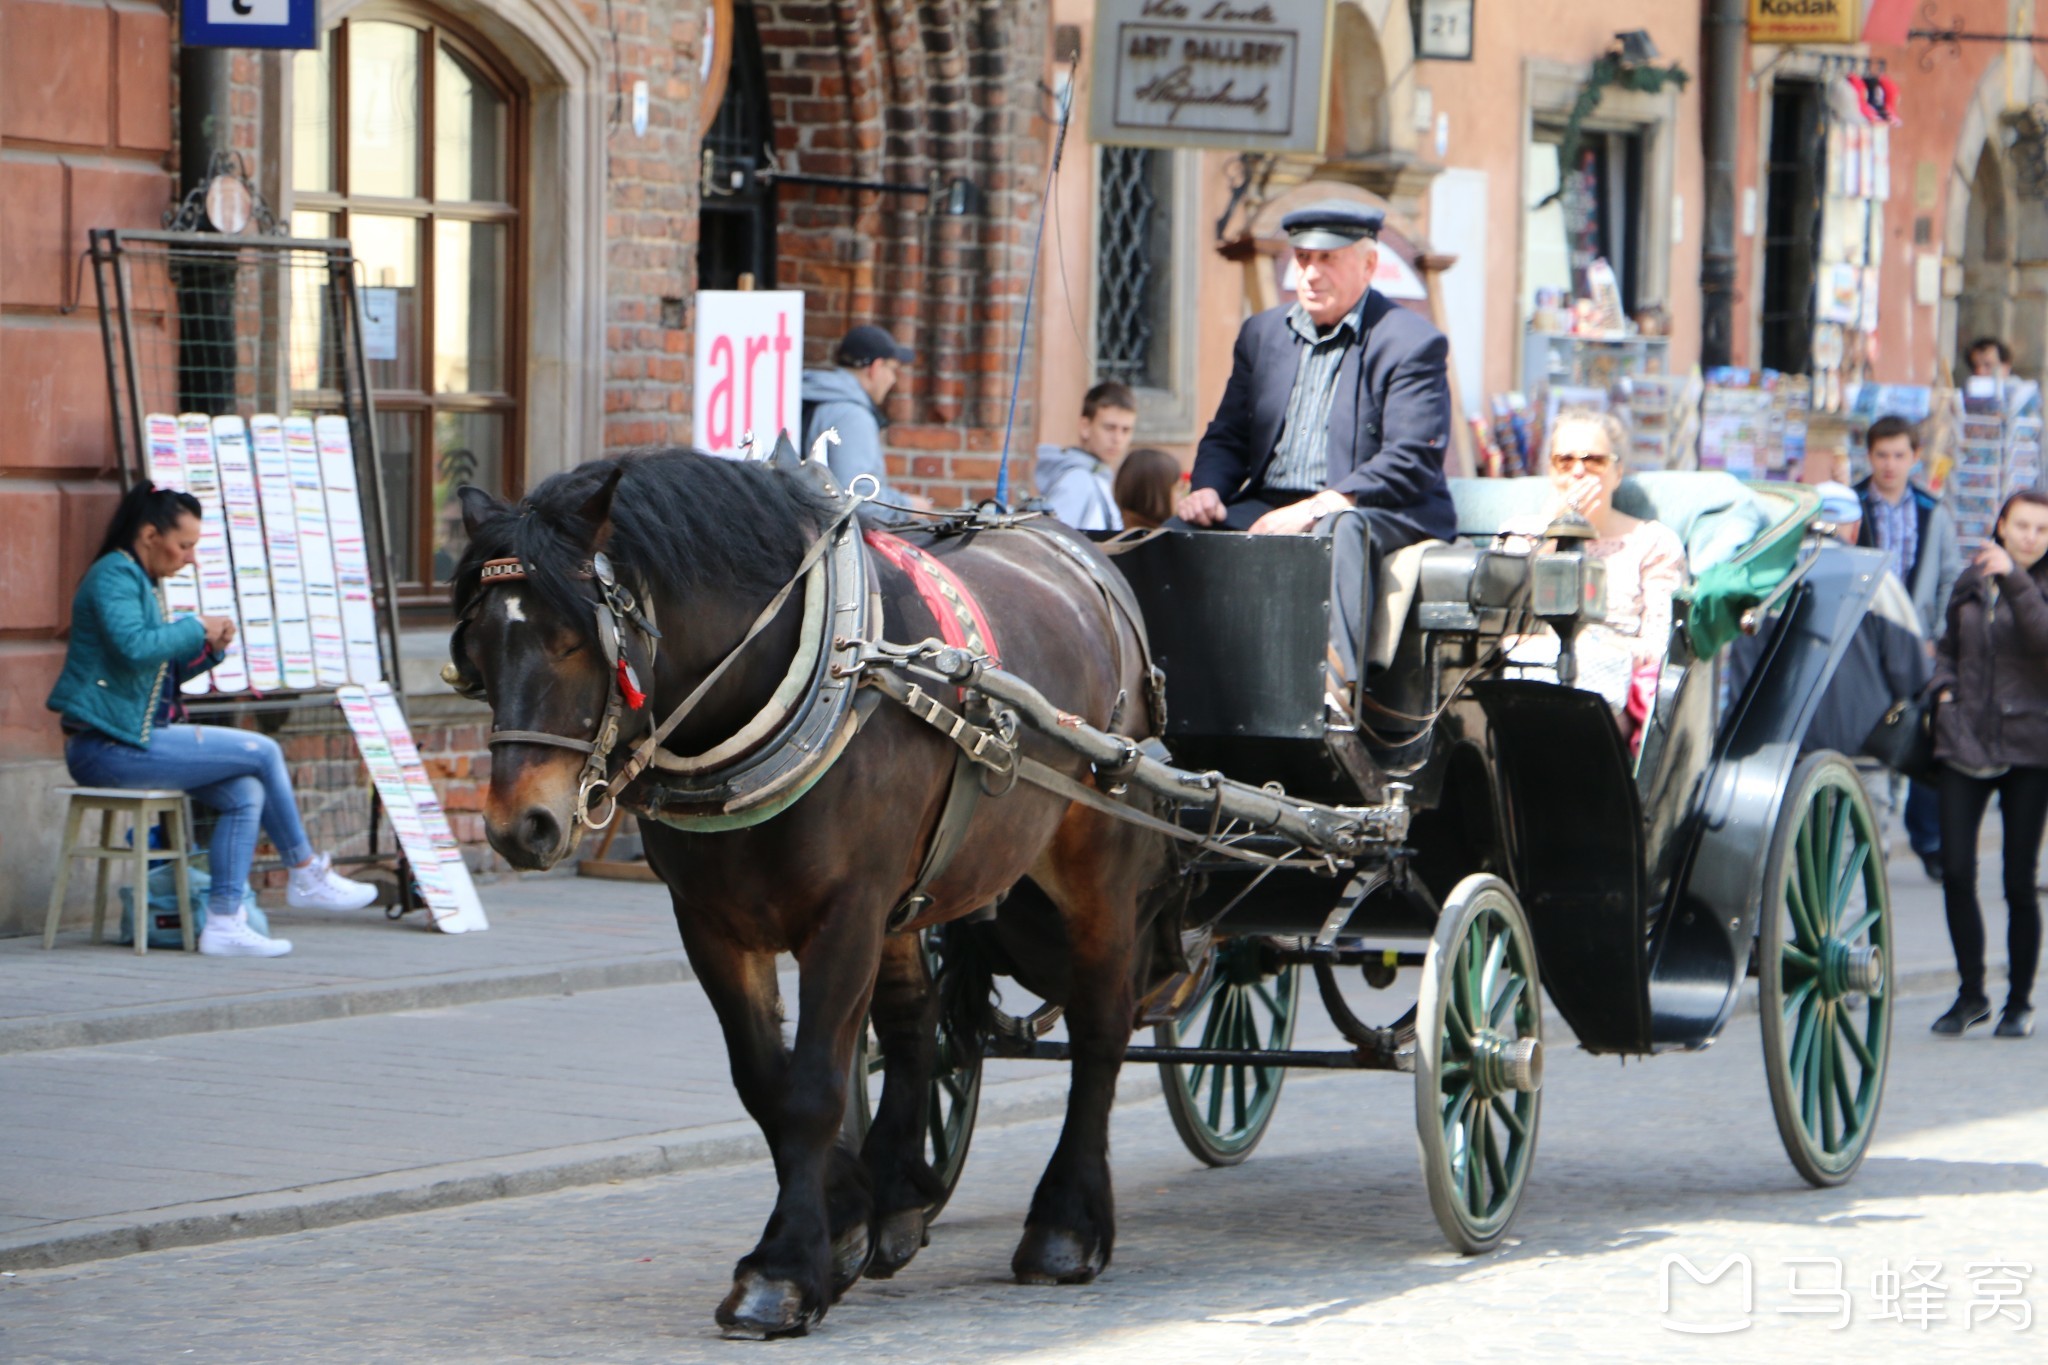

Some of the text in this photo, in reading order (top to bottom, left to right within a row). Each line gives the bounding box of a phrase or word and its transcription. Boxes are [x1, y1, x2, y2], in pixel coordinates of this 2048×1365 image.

[1759, 0, 1838, 16] Kodak
[1430, 14, 1458, 37] 21
[1129, 36, 1284, 65] ART GALLERY
[707, 311, 792, 453] art
